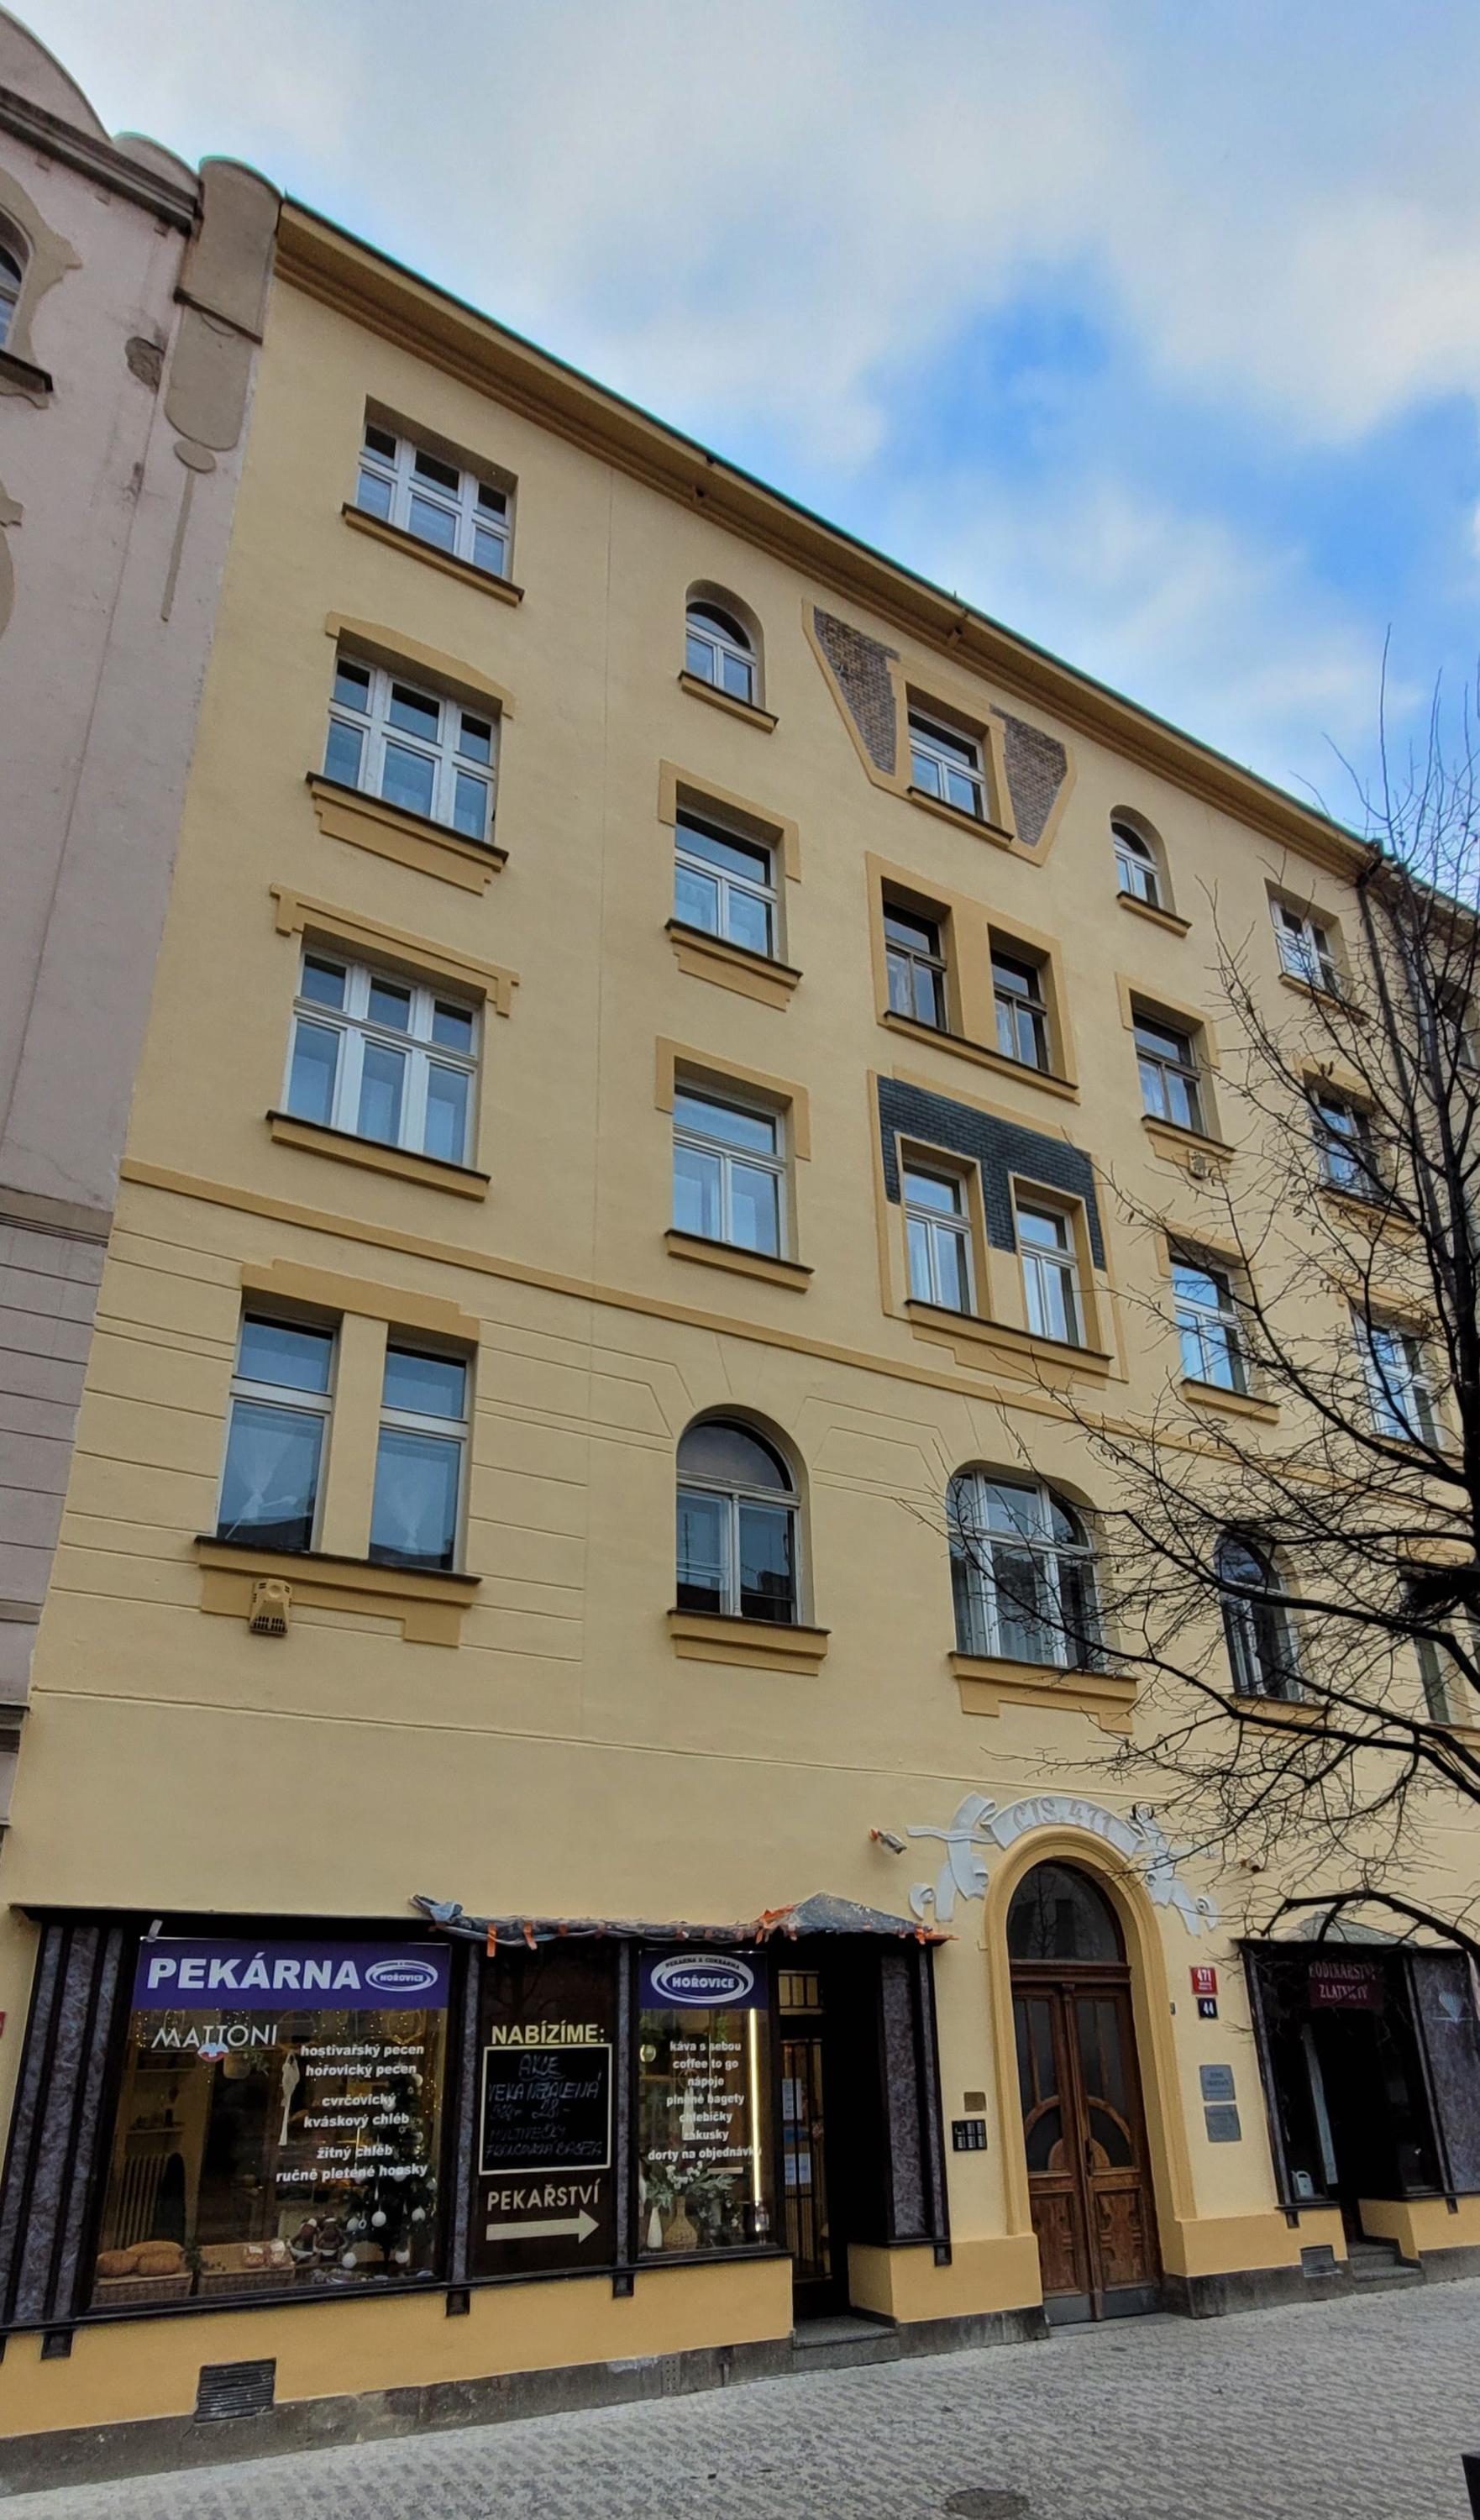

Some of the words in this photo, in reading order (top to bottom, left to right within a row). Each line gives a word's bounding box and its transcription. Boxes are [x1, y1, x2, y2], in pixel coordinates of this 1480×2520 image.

[147, 1951, 361, 1990] PEKÁRNA
[1197, 1968, 1212, 1982] 471
[672, 1974, 735, 1989] HOŘOVICE
[1203, 2002, 1215, 2015] 44
[150, 2024, 277, 2049] MATTONI
[491, 2019, 605, 2045] NABÍZÍME:
[301, 2044, 380, 2058] hostivařský
[384, 2045, 424, 2057] pecen
[669, 2040, 697, 2051] káva
[700, 2042, 706, 2051] s
[709, 2041, 742, 2051] sebou
[306, 2064, 372, 2078] hořovický
[375, 2065, 417, 2076] pecen
[672, 2058, 708, 2069] coffee
[711, 2060, 722, 2069] to
[725, 2060, 739, 2071] go
[687, 2076, 725, 2089] nápoje
[322, 2092, 396, 2108] cvrčovický
[666, 2093, 705, 2108] plnné
[706, 2092, 745, 2106] bagety
[303, 2114, 369, 2129] kváskový
[372, 2112, 410, 2126] chléb
[679, 2111, 733, 2124] clebíčky
[317, 2146, 352, 2161] žitný
[354, 2143, 393, 2158] chléb
[648, 2150, 679, 2162] dorty
[681, 2150, 696, 2160] na
[276, 2169, 318, 2183] ručně
[322, 2166, 376, 2182] pletené
[487, 2178, 601, 2212] PEKAŘSTVÍ
